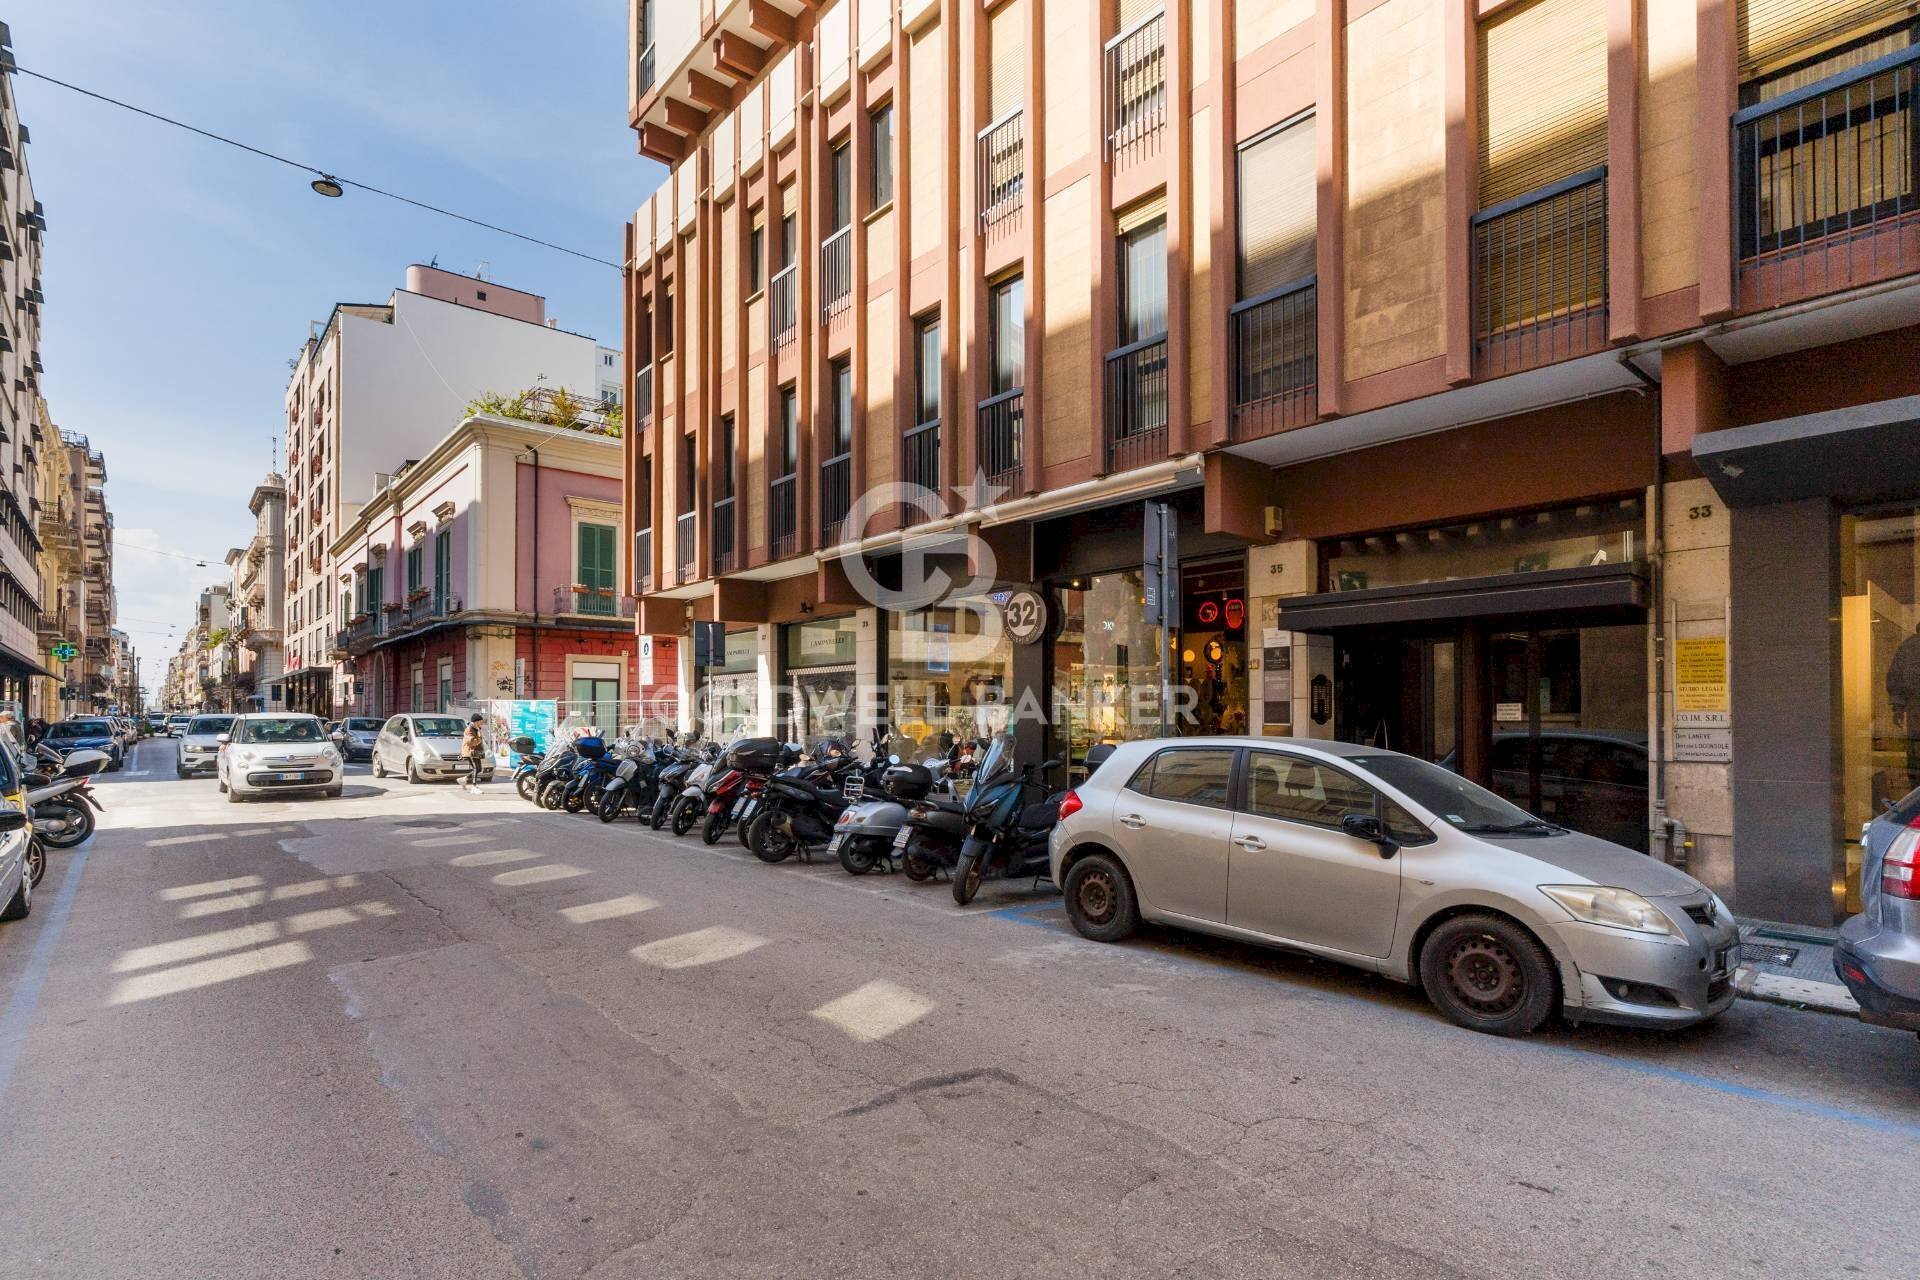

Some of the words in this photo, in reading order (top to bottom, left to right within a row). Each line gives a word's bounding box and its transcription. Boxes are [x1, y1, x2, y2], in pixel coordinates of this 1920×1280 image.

[1689, 505, 1711, 519] 33
[1270, 564, 1283, 574] 35
[1008, 600, 1036, 628] 32
